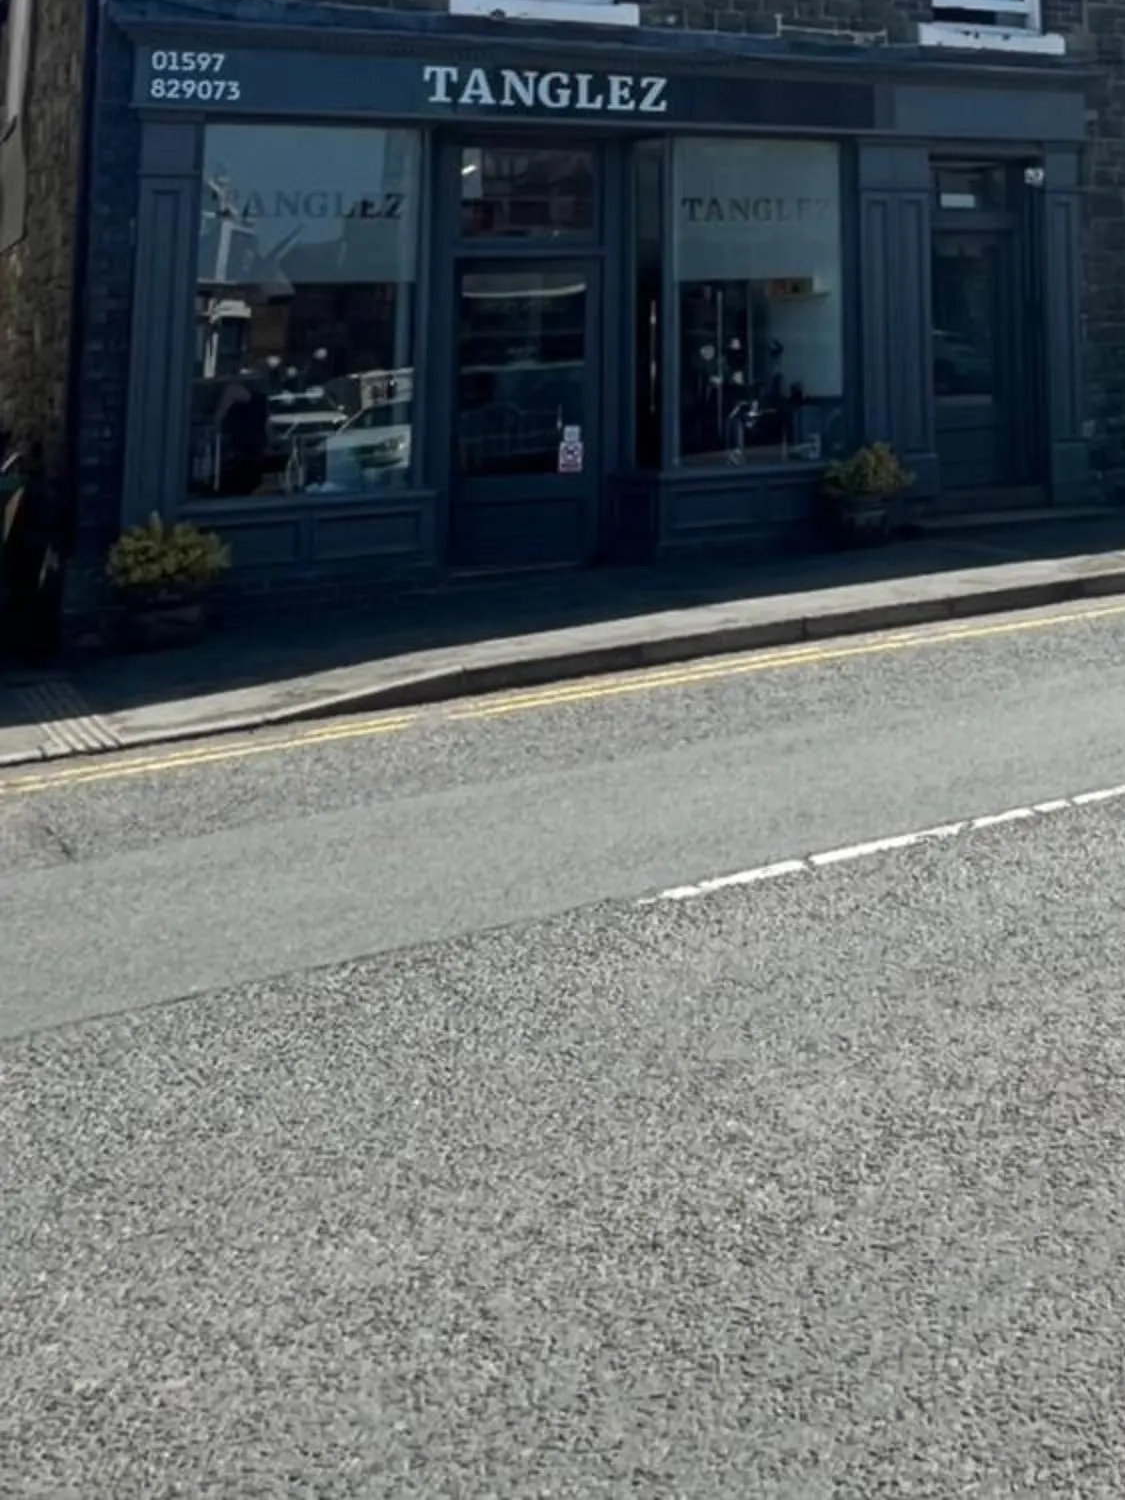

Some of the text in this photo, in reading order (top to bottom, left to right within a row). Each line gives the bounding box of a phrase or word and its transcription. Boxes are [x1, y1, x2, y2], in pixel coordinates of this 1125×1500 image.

[151, 50, 226, 73] 01597
[150, 78, 241, 101] 829073
[422, 65, 669, 113] TANGLEZ
